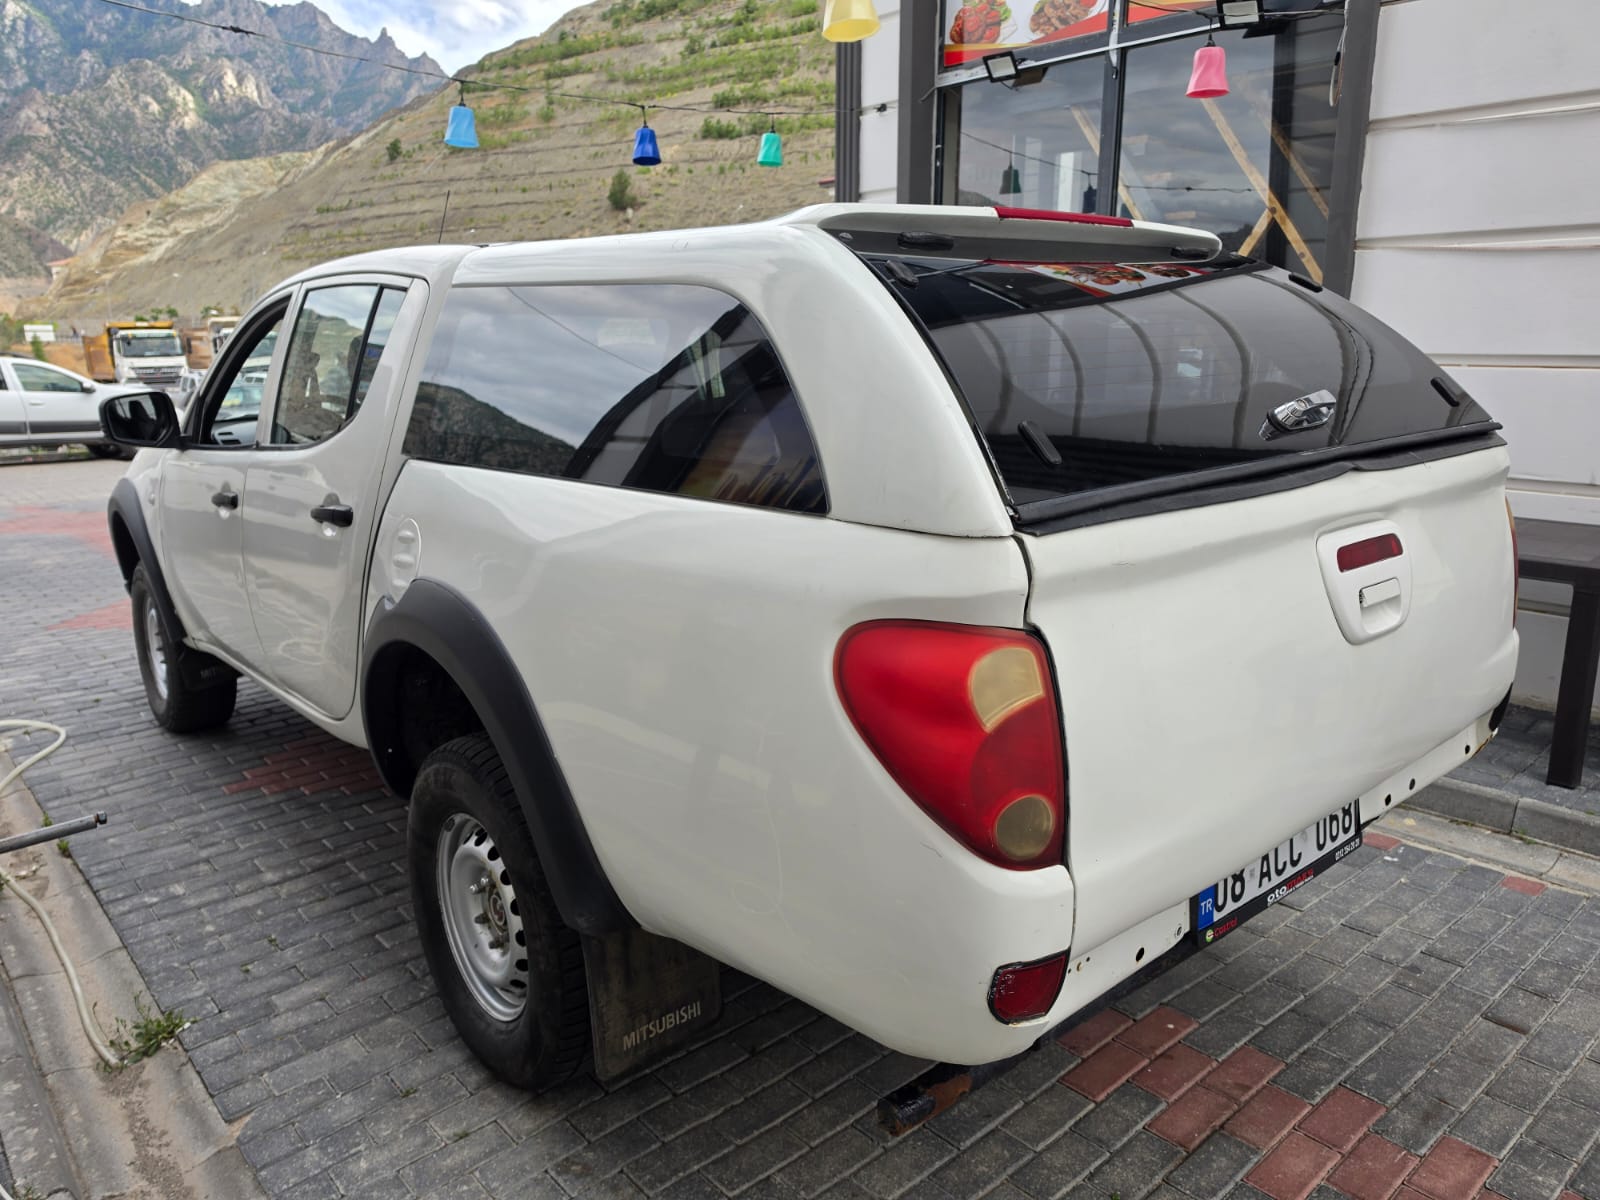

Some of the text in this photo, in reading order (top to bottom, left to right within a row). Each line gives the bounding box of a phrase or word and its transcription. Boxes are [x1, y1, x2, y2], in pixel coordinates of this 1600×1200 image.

[1201, 898, 1213, 915] TR
[1214, 868, 1245, 912] 08
[1259, 838, 1302, 888] ACC
[1316, 802, 1352, 851] 068
[623, 1001, 700, 1051] MITSUBISHI
